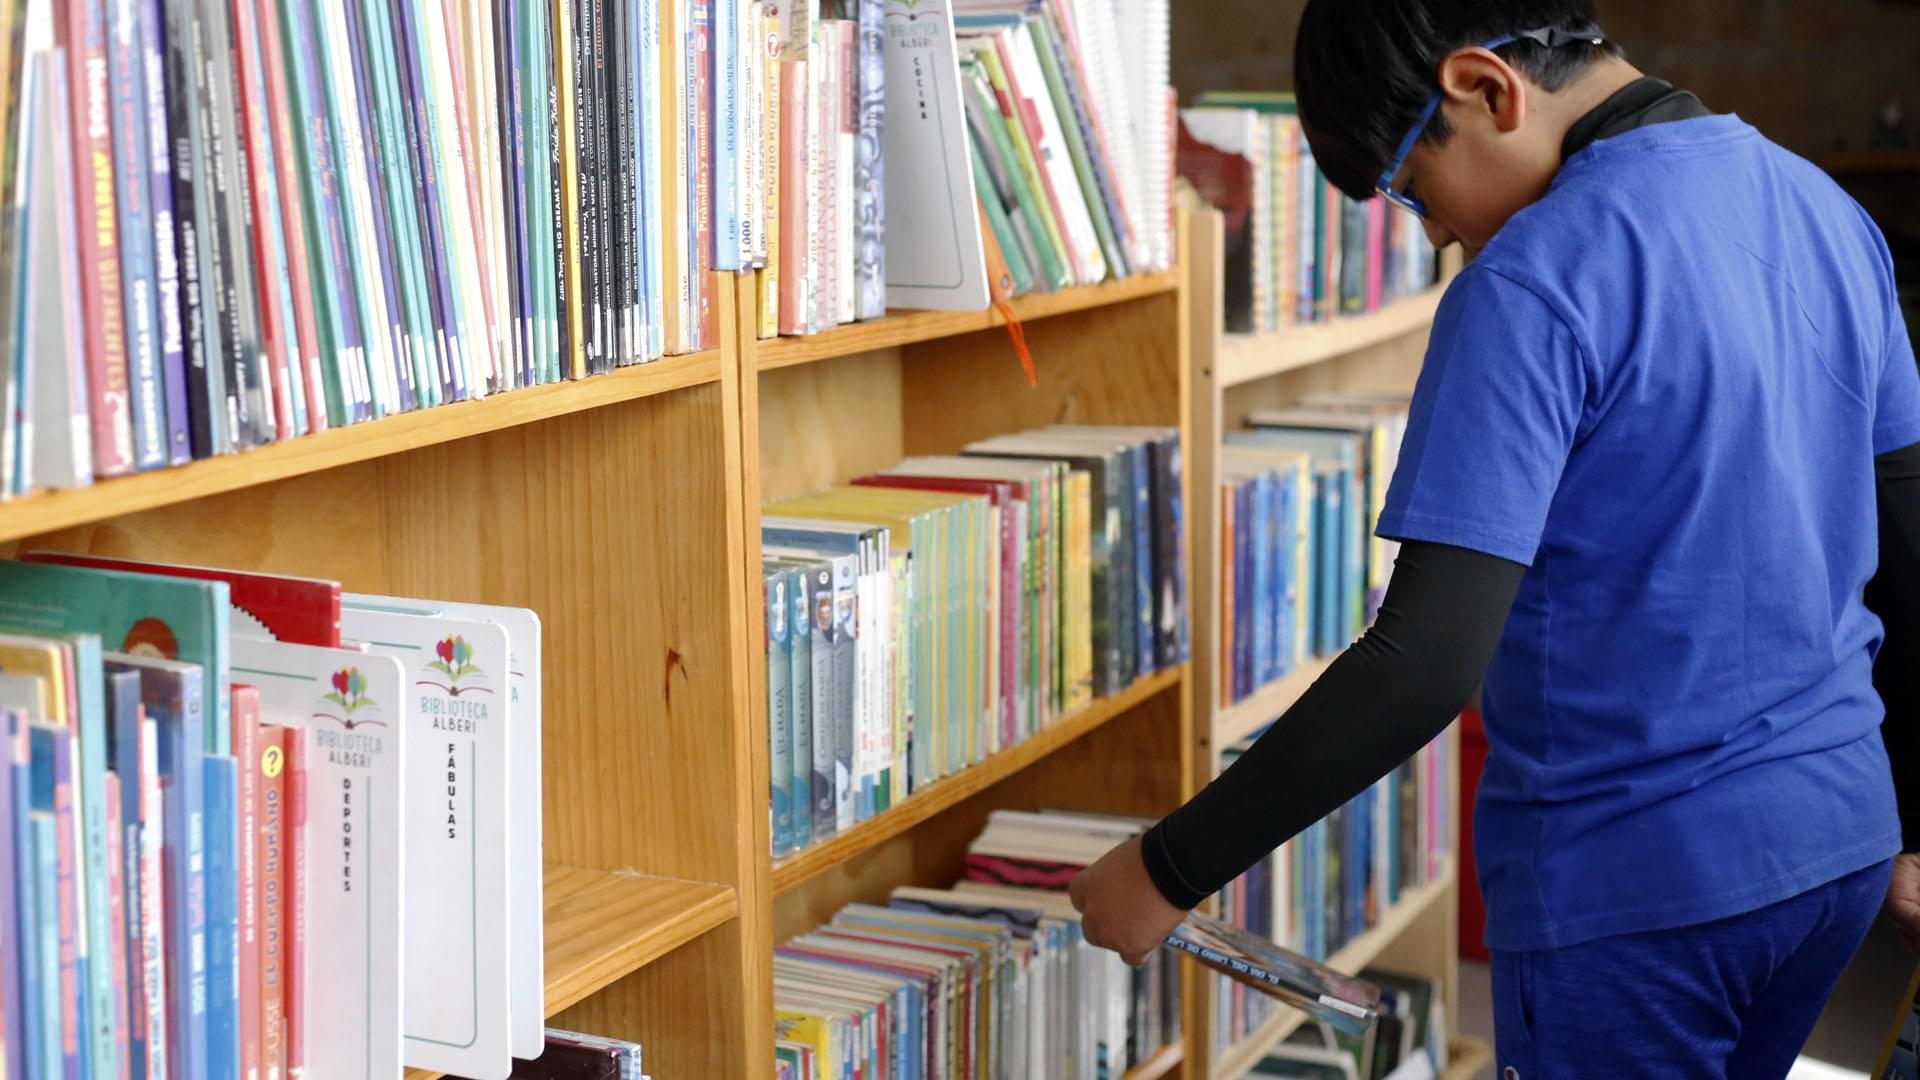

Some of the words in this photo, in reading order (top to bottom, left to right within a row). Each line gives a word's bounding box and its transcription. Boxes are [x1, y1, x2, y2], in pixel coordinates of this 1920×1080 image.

[549, 85, 558, 124] Kahlo
[913, 57, 927, 119] COCINA
[552, 126, 560, 162] Frida
[698, 111, 707, 158] momias
[767, 145, 776, 196] MUNDO
[698, 173, 708, 232] Pirámides
[743, 193, 752, 218] datos
[741, 220, 752, 254] 1.000
[420, 696, 488, 720] BIBLIOTECA
[775, 685, 785, 731] HADA
[797, 679, 808, 724] HADA
[316, 729, 383, 753] BIBLIOTECA
[432, 716, 477, 734] ALBERI
[328, 750, 372, 768] ALBERI
[776, 736, 786, 754] EL
[264, 789, 279, 873] HUMANO
[343, 778, 351, 892] DEPORTES
[246, 887, 254, 925] COSAS
[1186, 943, 1200, 954] DE
[1200, 949, 1229, 965] LIBRO
[1230, 959, 1248, 972] DEL
[266, 962, 278, 985] EL
[1267, 974, 1279, 984] EL
